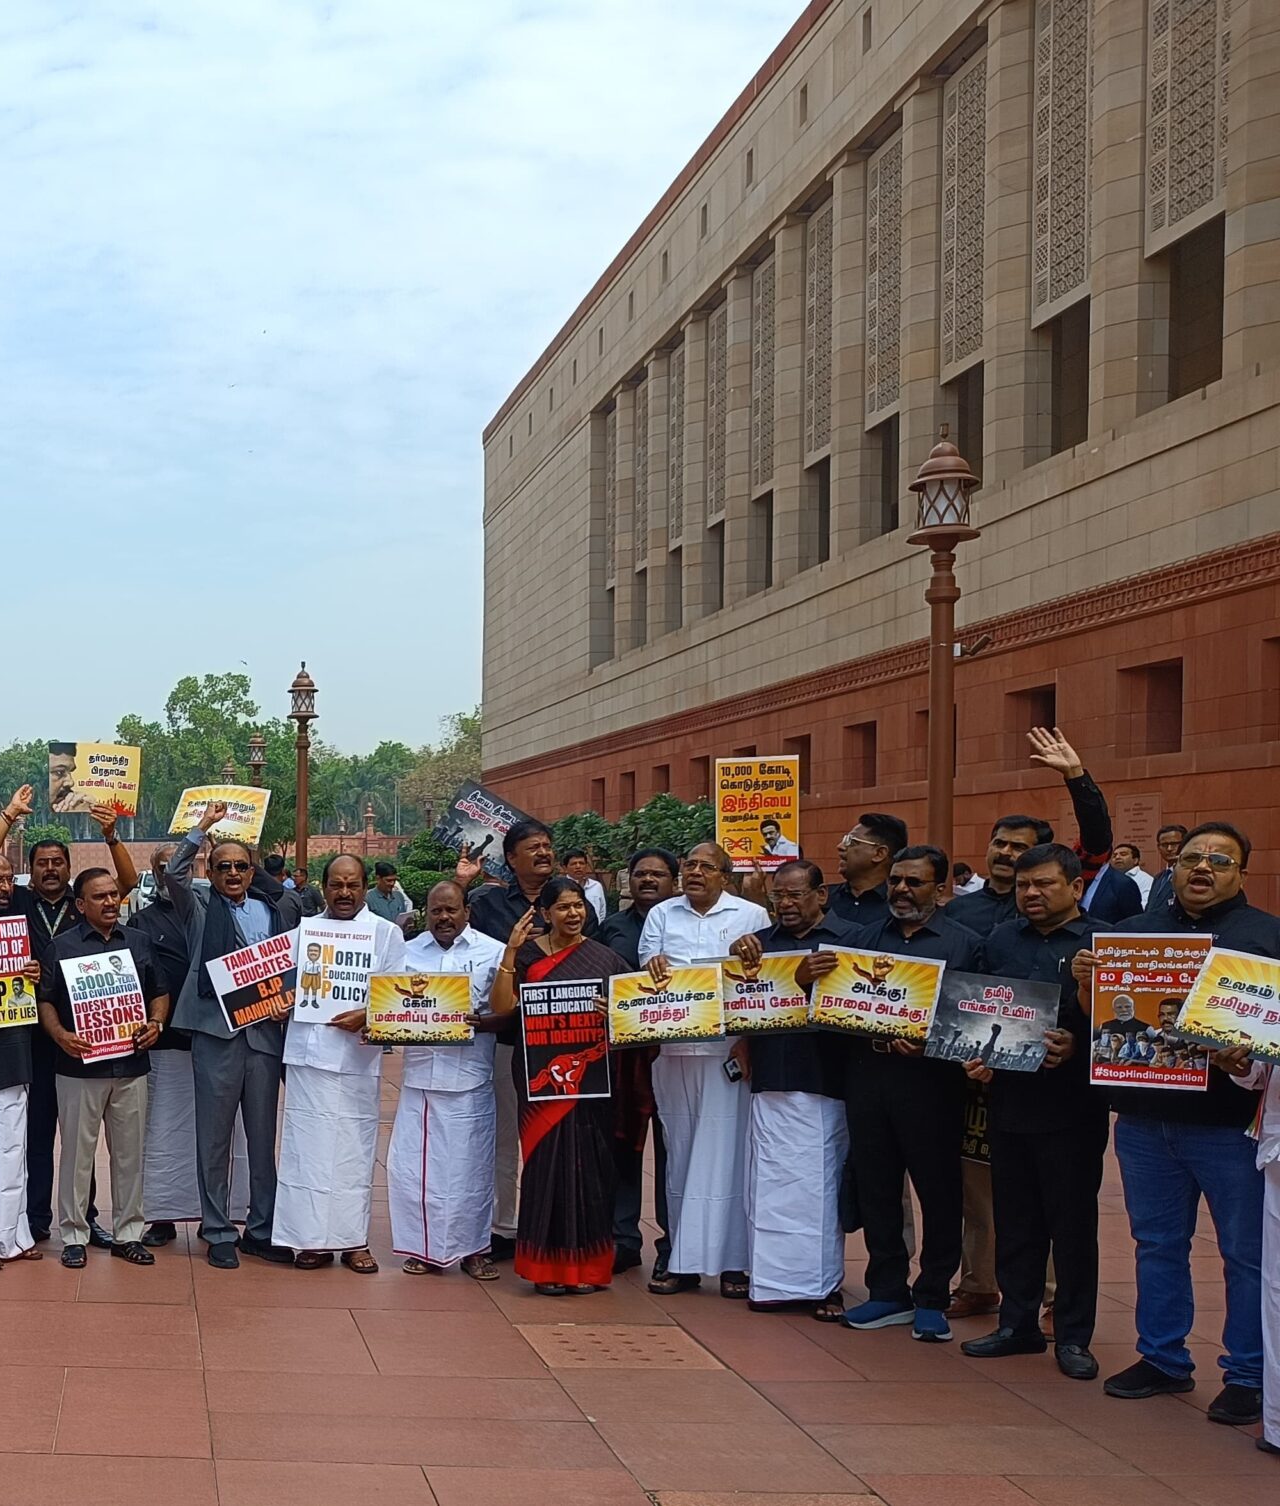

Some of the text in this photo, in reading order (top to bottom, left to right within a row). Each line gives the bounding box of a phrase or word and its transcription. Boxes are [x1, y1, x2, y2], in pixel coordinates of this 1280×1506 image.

[89, 753, 129, 766] தர்மேந்திர
[721, 763, 791, 778] 10,000 கோடி
[720, 776, 794, 792] கொடுத்தாலும்
[721, 793, 792, 813] இந்தியை
[0, 922, 27, 939] NADU
[11, 939, 24, 955] OF
[222, 935, 291, 971] TAMIL NADU
[1097, 946, 1208, 958] தமிழ்நாட்டில் இருக்கும்
[322, 944, 371, 968] NORTH
[233, 954, 296, 987] EDUCATES.
[1100, 972, 1116, 982] 80
[1121, 971, 1173, 984] இலட்சம்
[73, 983, 138, 1001] OLD CIVILIZATION
[257, 976, 283, 998] BJP
[321, 980, 367, 1003] POLICY
[523, 989, 548, 1002] FIRST
[735, 980, 774, 994] கேள்!
[852, 982, 907, 1002] அடக்கு!
[984, 986, 1013, 1002] தமிழ்
[1218, 977, 1273, 997] உலகம்
[74, 993, 142, 1014] DOESN'T NEED
[402, 996, 437, 1008] கேள்!
[617, 990, 715, 1010] ஆணவப்பேச்சை
[770, 994, 809, 1008] கேள்!
[821, 995, 927, 1022] நாவை அடக்கு!
[1206, 996, 1261, 1015] தமிழர்
[8, 1008, 18, 1021] OF
[20, 1006, 37, 1019] LIES
[76, 1004, 144, 1031] LESSONS
[374, 1010, 428, 1024] மன்னிப்பு
[525, 1003, 549, 1015] THEN
[639, 1006, 690, 1024] நிறுத்து!
[960, 1000, 1034, 1019] எங்கள் உயிர்!
[525, 1013, 603, 1030] WHAT'S NEXT?
[78, 1027, 115, 1043] FROM
[527, 1028, 604, 1046] OUR IDENTITY?
[1094, 1066, 1203, 1083] #StopHindiImposition
